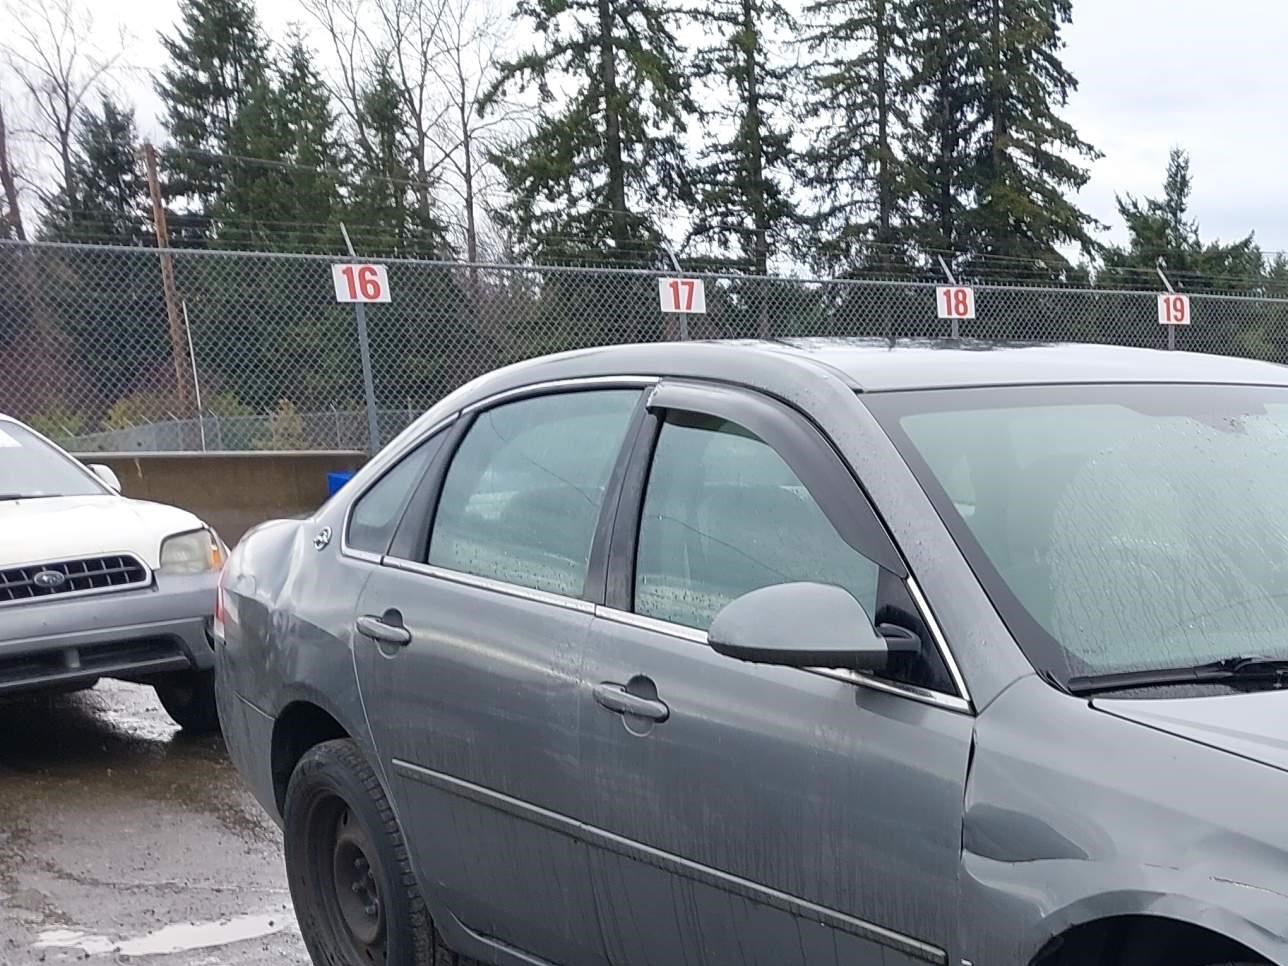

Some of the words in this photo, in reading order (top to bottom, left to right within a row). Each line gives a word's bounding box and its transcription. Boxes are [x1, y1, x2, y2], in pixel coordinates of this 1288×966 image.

[343, 266, 382, 301] 16
[669, 280, 696, 310] 17
[944, 289, 969, 317] 18
[1163, 296, 1186, 322] 19
